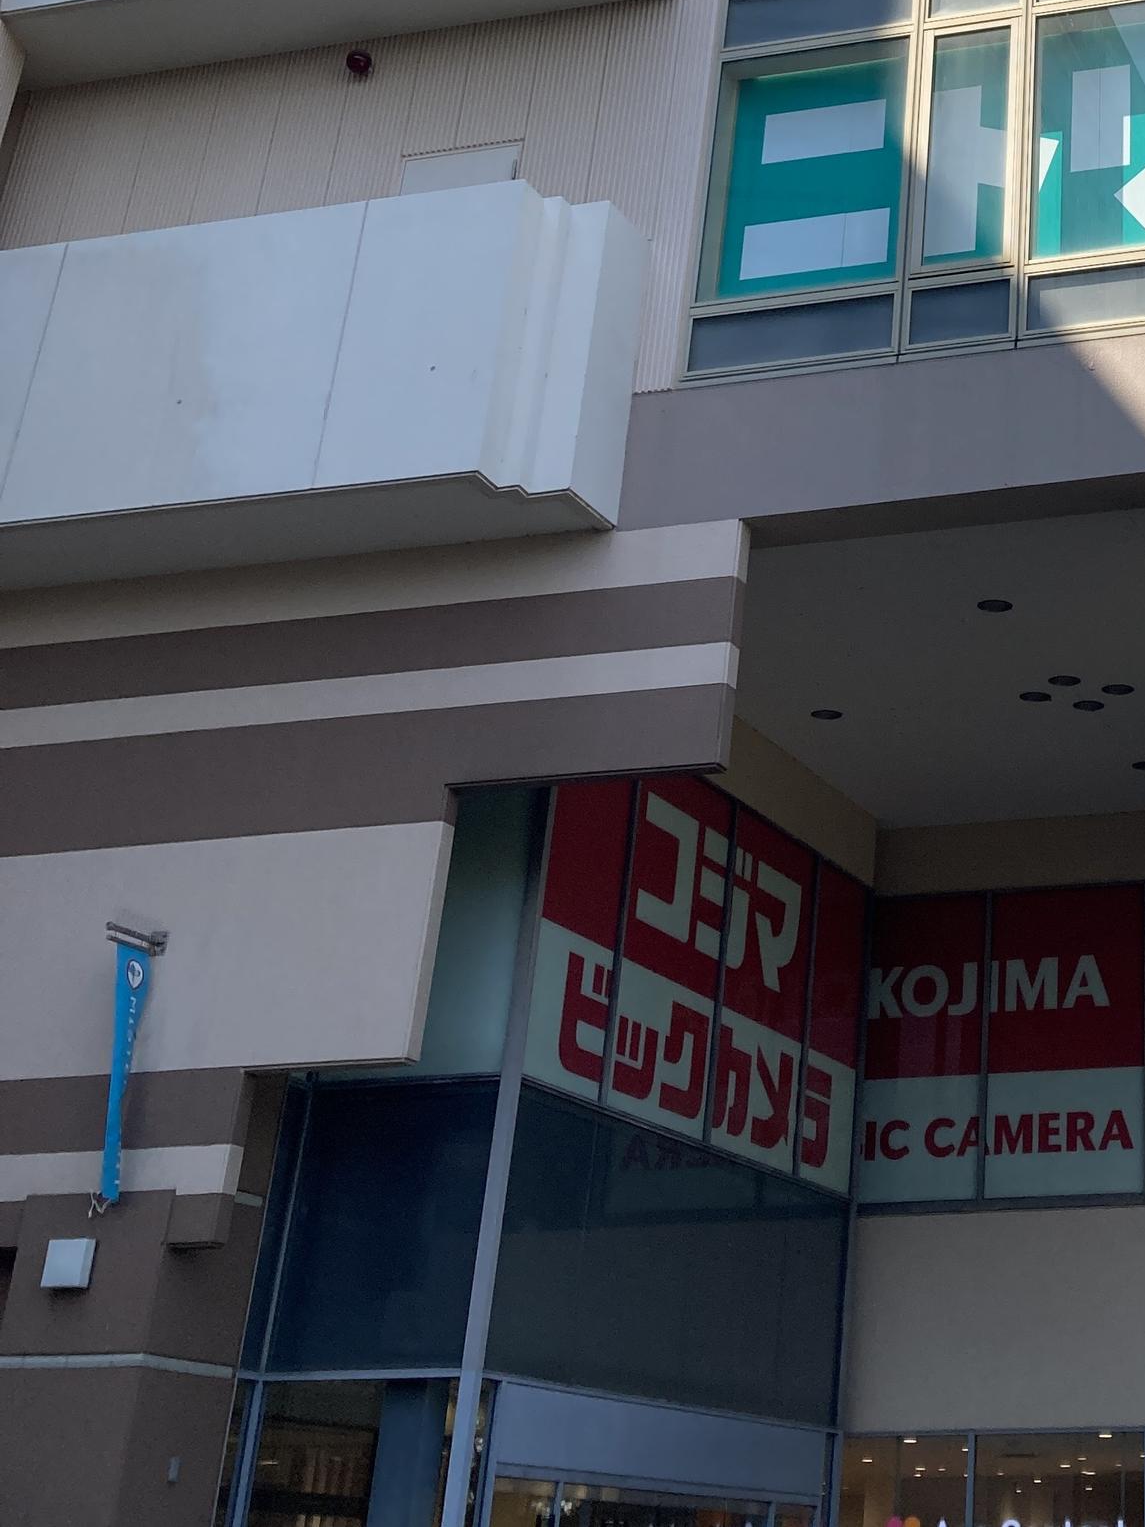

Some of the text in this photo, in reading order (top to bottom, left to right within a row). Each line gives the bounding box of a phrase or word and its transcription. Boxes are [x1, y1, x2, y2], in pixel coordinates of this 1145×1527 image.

[636, 791, 802, 992] コジマ
[867, 954, 1110, 1019] KOJIMA
[558, 951, 832, 1168] ビックカメラ
[860, 1110, 1134, 1161] IC CAMERA
